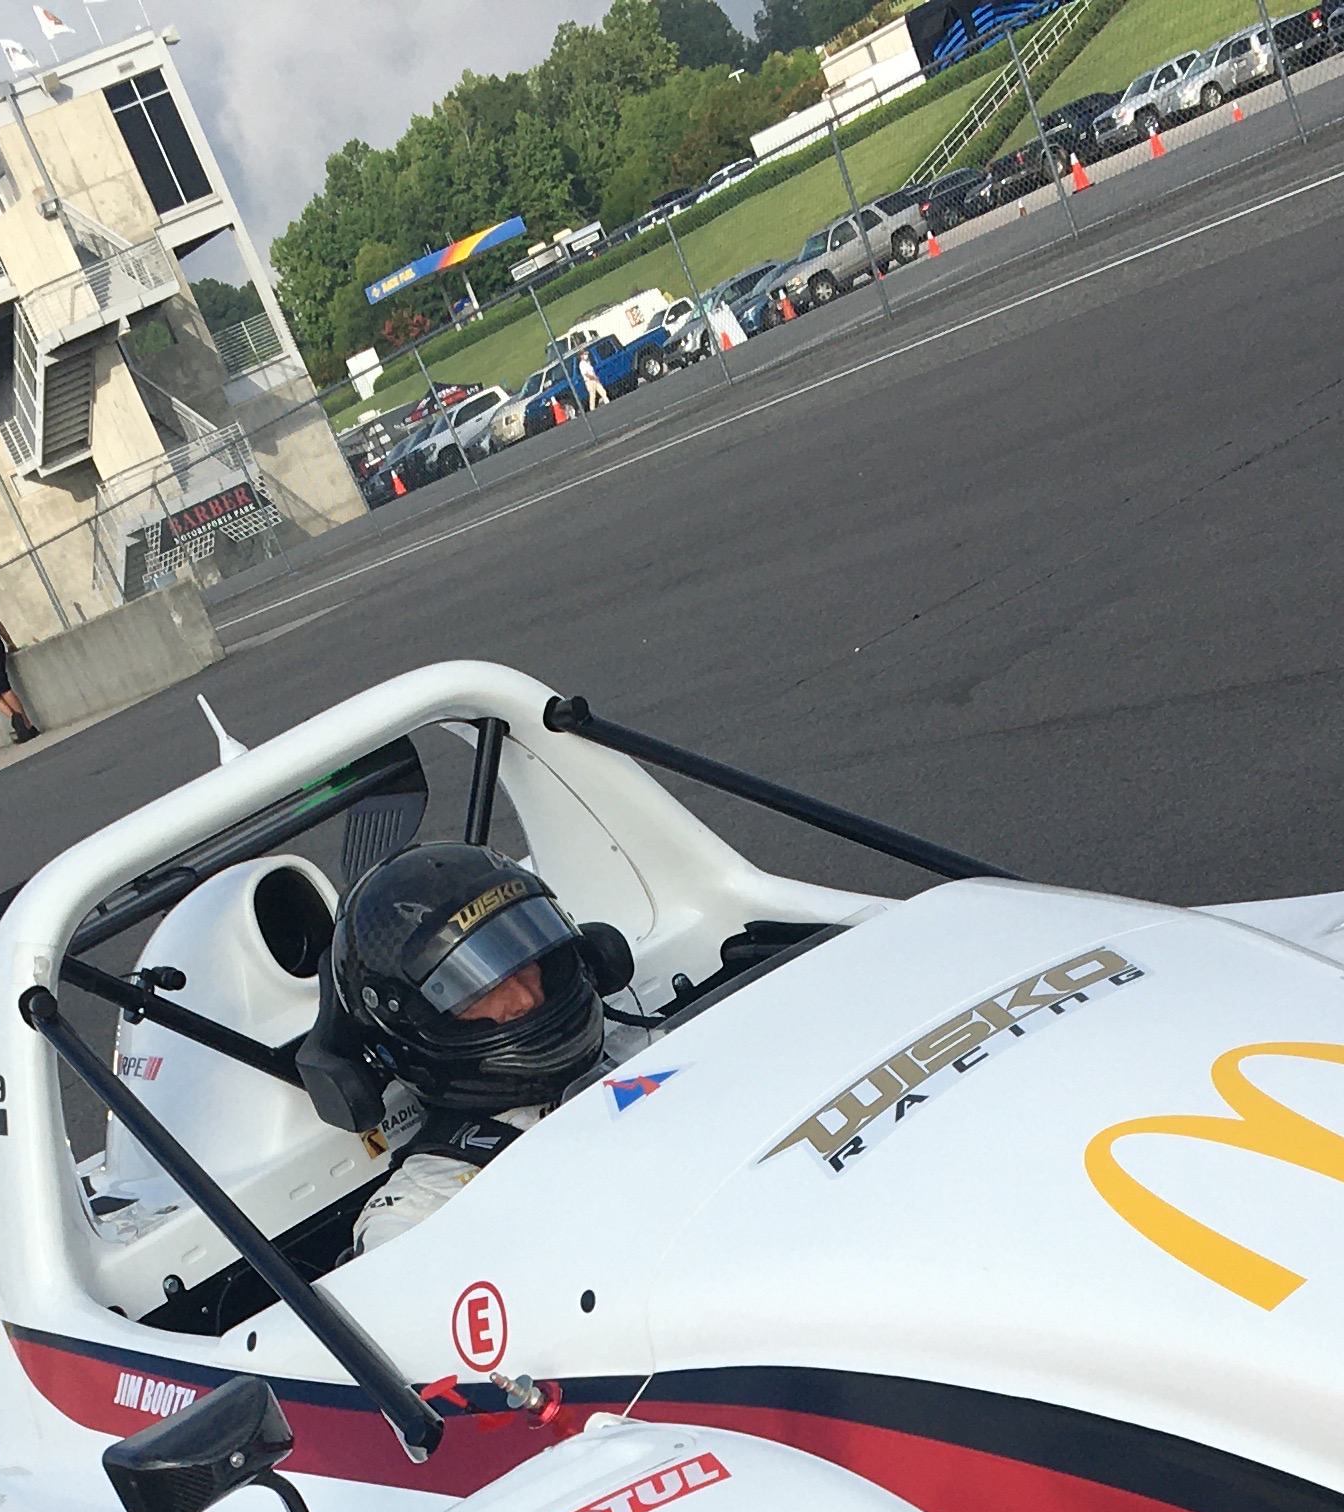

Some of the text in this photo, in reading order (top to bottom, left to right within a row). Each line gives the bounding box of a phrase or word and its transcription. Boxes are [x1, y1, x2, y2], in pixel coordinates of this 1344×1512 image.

[165, 486, 252, 537] BARBER
[234, 502, 256, 517] PARK
[447, 879, 528, 932] WISKO
[757, 945, 1134, 1164] WISKO
[467, 1296, 495, 1354] E
[114, 1372, 197, 1417] JIM BOOTH
